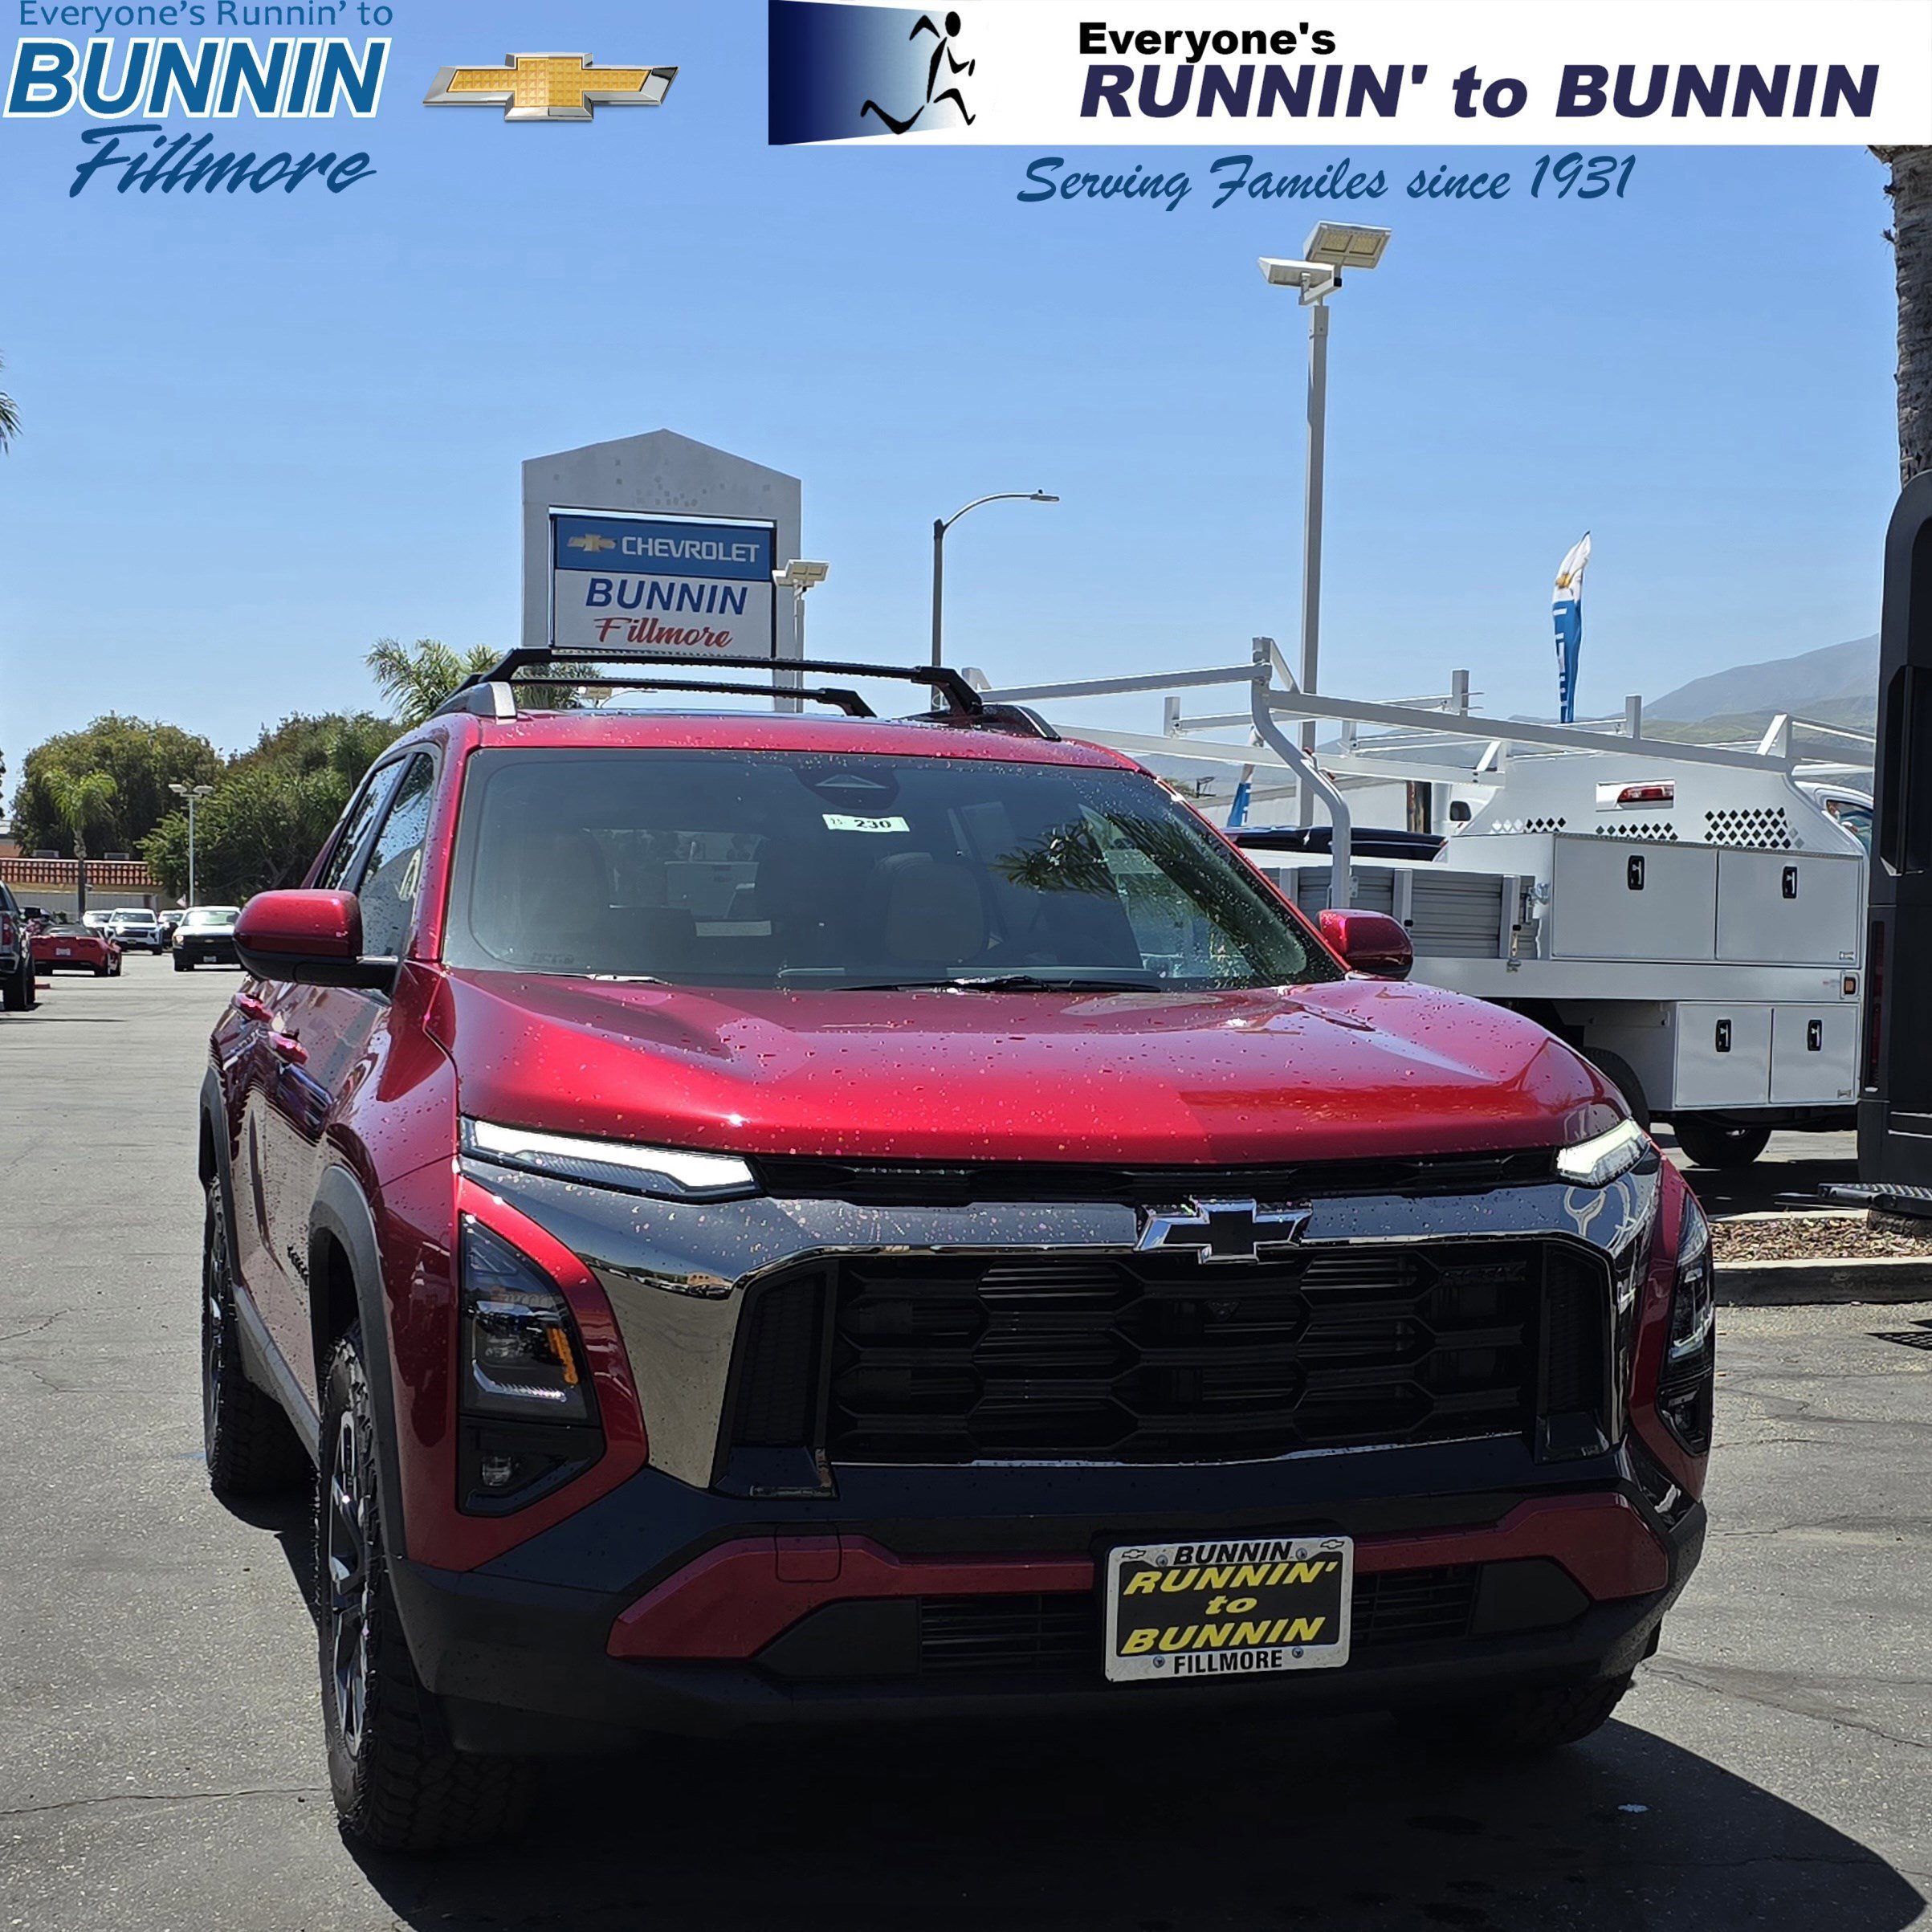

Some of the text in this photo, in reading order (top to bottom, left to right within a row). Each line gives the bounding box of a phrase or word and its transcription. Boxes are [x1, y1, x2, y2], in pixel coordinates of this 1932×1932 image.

[621, 536, 760, 563] CHEVROLET
[585, 577, 748, 615] BUNNIN
[593, 617, 734, 649] Fillmore
[1173, 1541, 1294, 1566] BUNNIN
[1123, 1560, 1339, 1596] RUNNIN'
[1204, 1595, 1258, 1616] to
[1120, 1616, 1326, 1655] BUNNIN
[1173, 1649, 1283, 1675] FILLMORE
